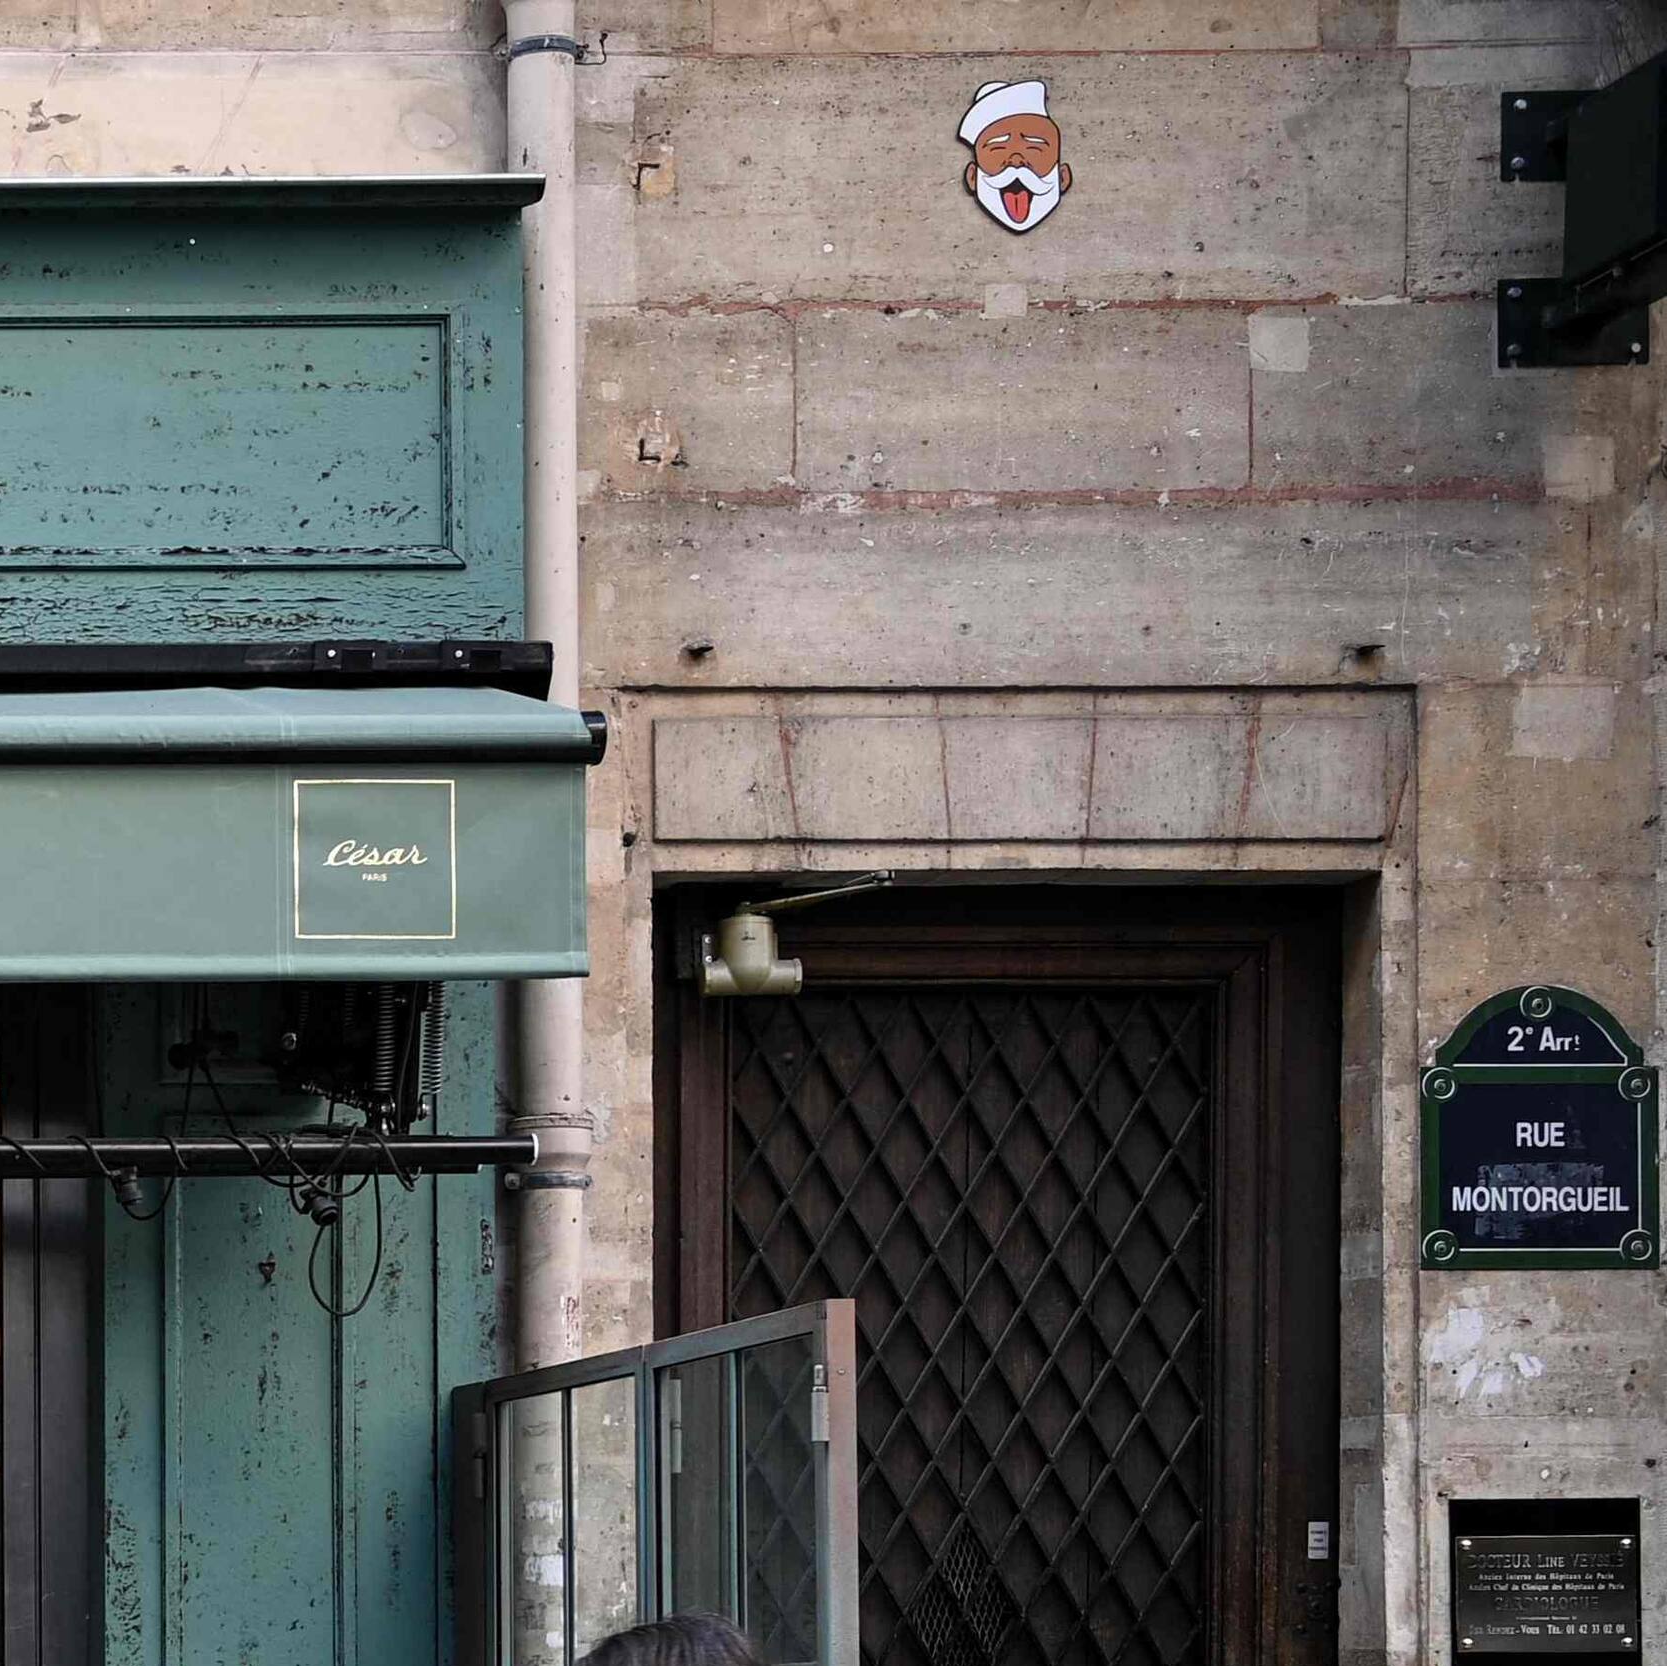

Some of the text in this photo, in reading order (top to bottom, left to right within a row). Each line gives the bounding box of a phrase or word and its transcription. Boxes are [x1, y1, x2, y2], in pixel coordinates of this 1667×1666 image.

[323, 839, 428, 867] César
[361, 872, 388, 883] PARIS
[1515, 1121, 1566, 1149] RUE
[1451, 1185, 1630, 1213] MONTORGUEIL
